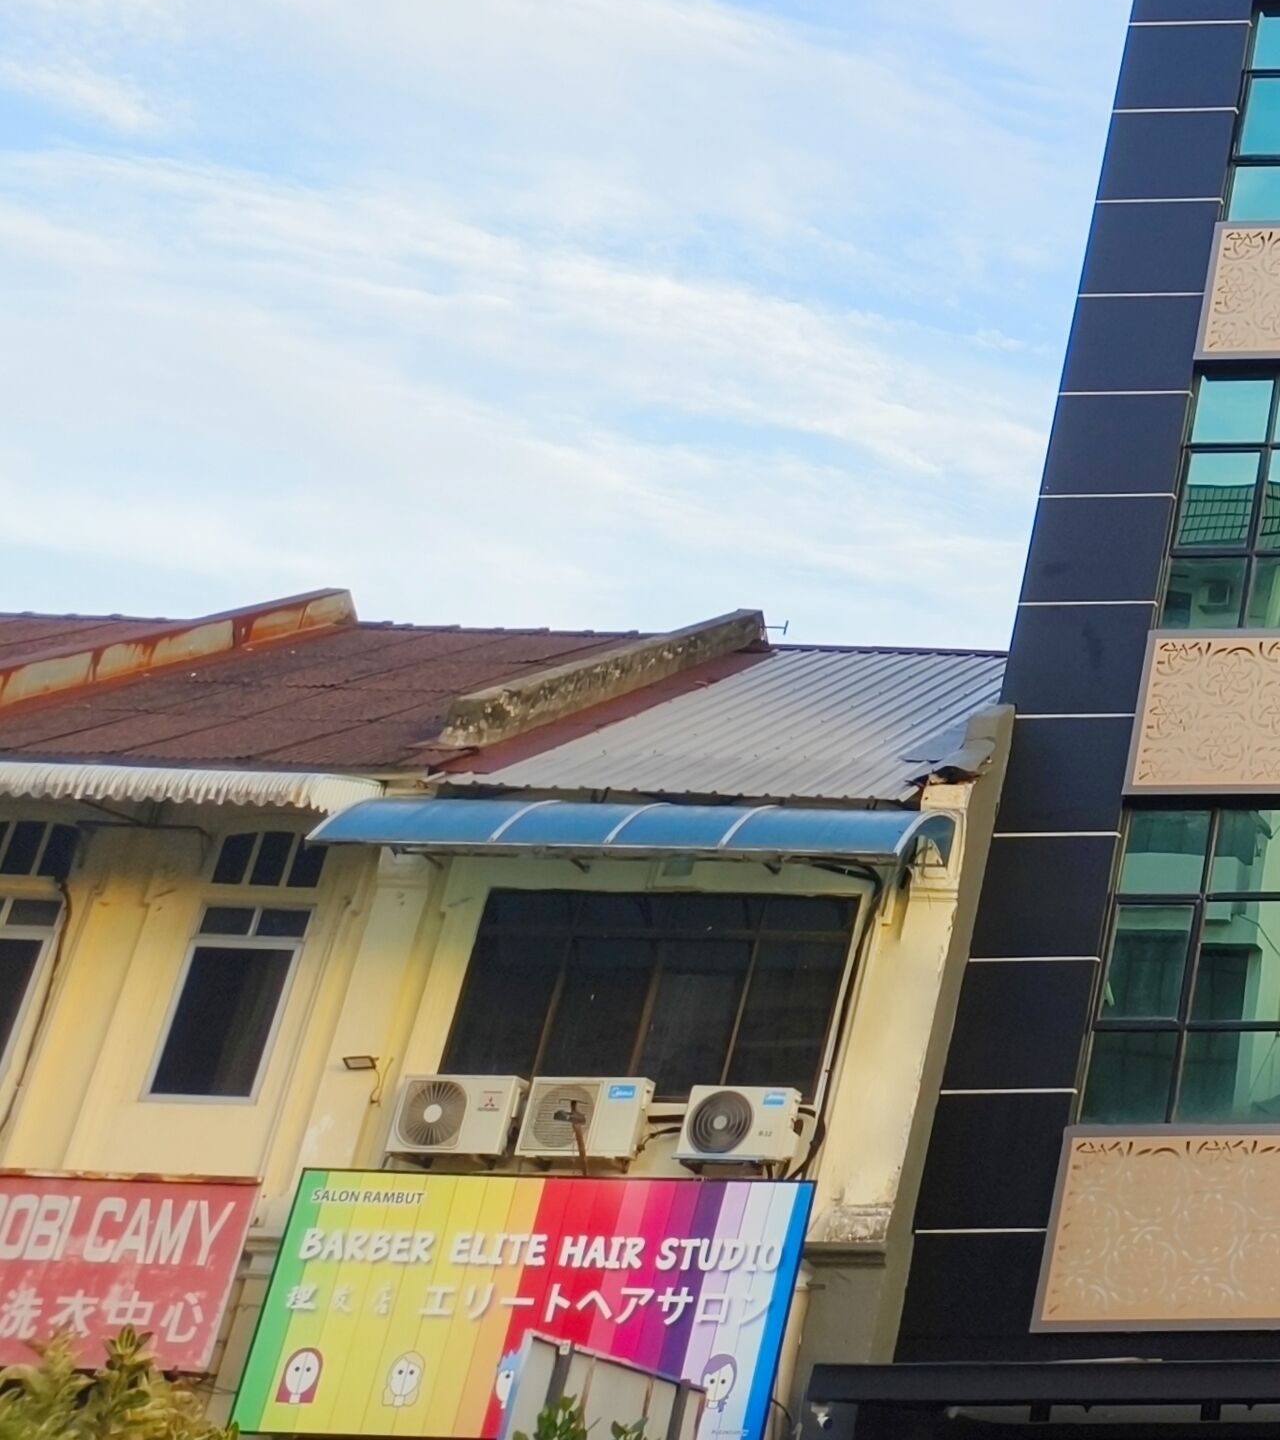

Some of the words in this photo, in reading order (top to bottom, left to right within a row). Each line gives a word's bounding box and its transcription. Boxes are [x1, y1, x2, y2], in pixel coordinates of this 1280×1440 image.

[312, 1189, 360, 1203] SALON
[362, 1191, 425, 1205] RAMBUT
[0, 1193, 81, 1262] OBI
[83, 1196, 237, 1266] CAMY
[299, 1227, 436, 1263] BARBER
[450, 1232, 548, 1266] ELITE
[558, 1234, 646, 1270] HAIR
[655, 1236, 784, 1273] STUDIO
[419, 1280, 773, 1327] エリートヘアサロン
